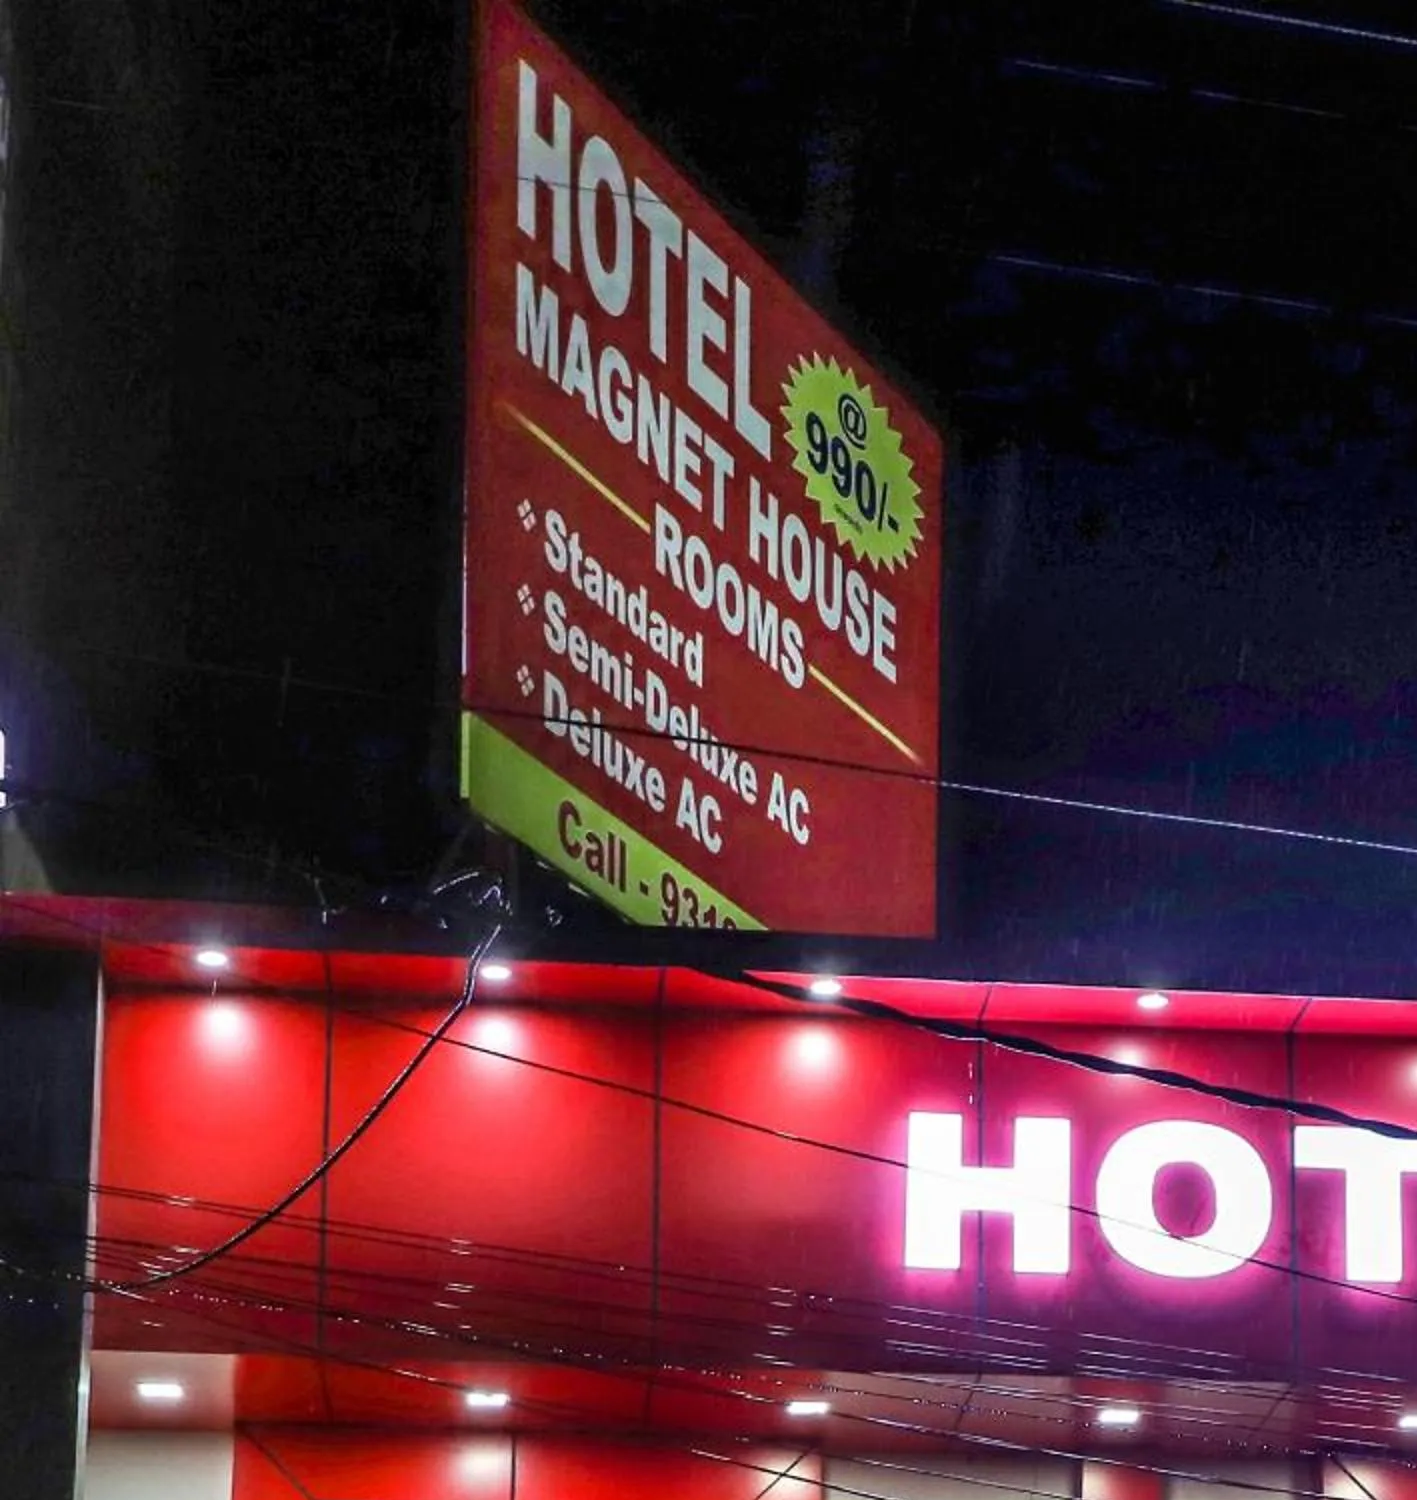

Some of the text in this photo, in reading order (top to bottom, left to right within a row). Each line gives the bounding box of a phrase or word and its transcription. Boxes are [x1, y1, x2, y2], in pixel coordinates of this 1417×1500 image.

[516, 57, 770, 462] HOTEL
[516, 262, 897, 685] MAGNET HOUSE
[806, 412, 899, 533] 990/-
[838, 393, 867, 450] @
[544, 510, 704, 687] Standard
[655, 503, 805, 688] ROOMS
[543, 590, 810, 845] Semi-Deluxe AC
[543, 671, 722, 853] Deluxe AC
[557, 801, 627, 893] Call
